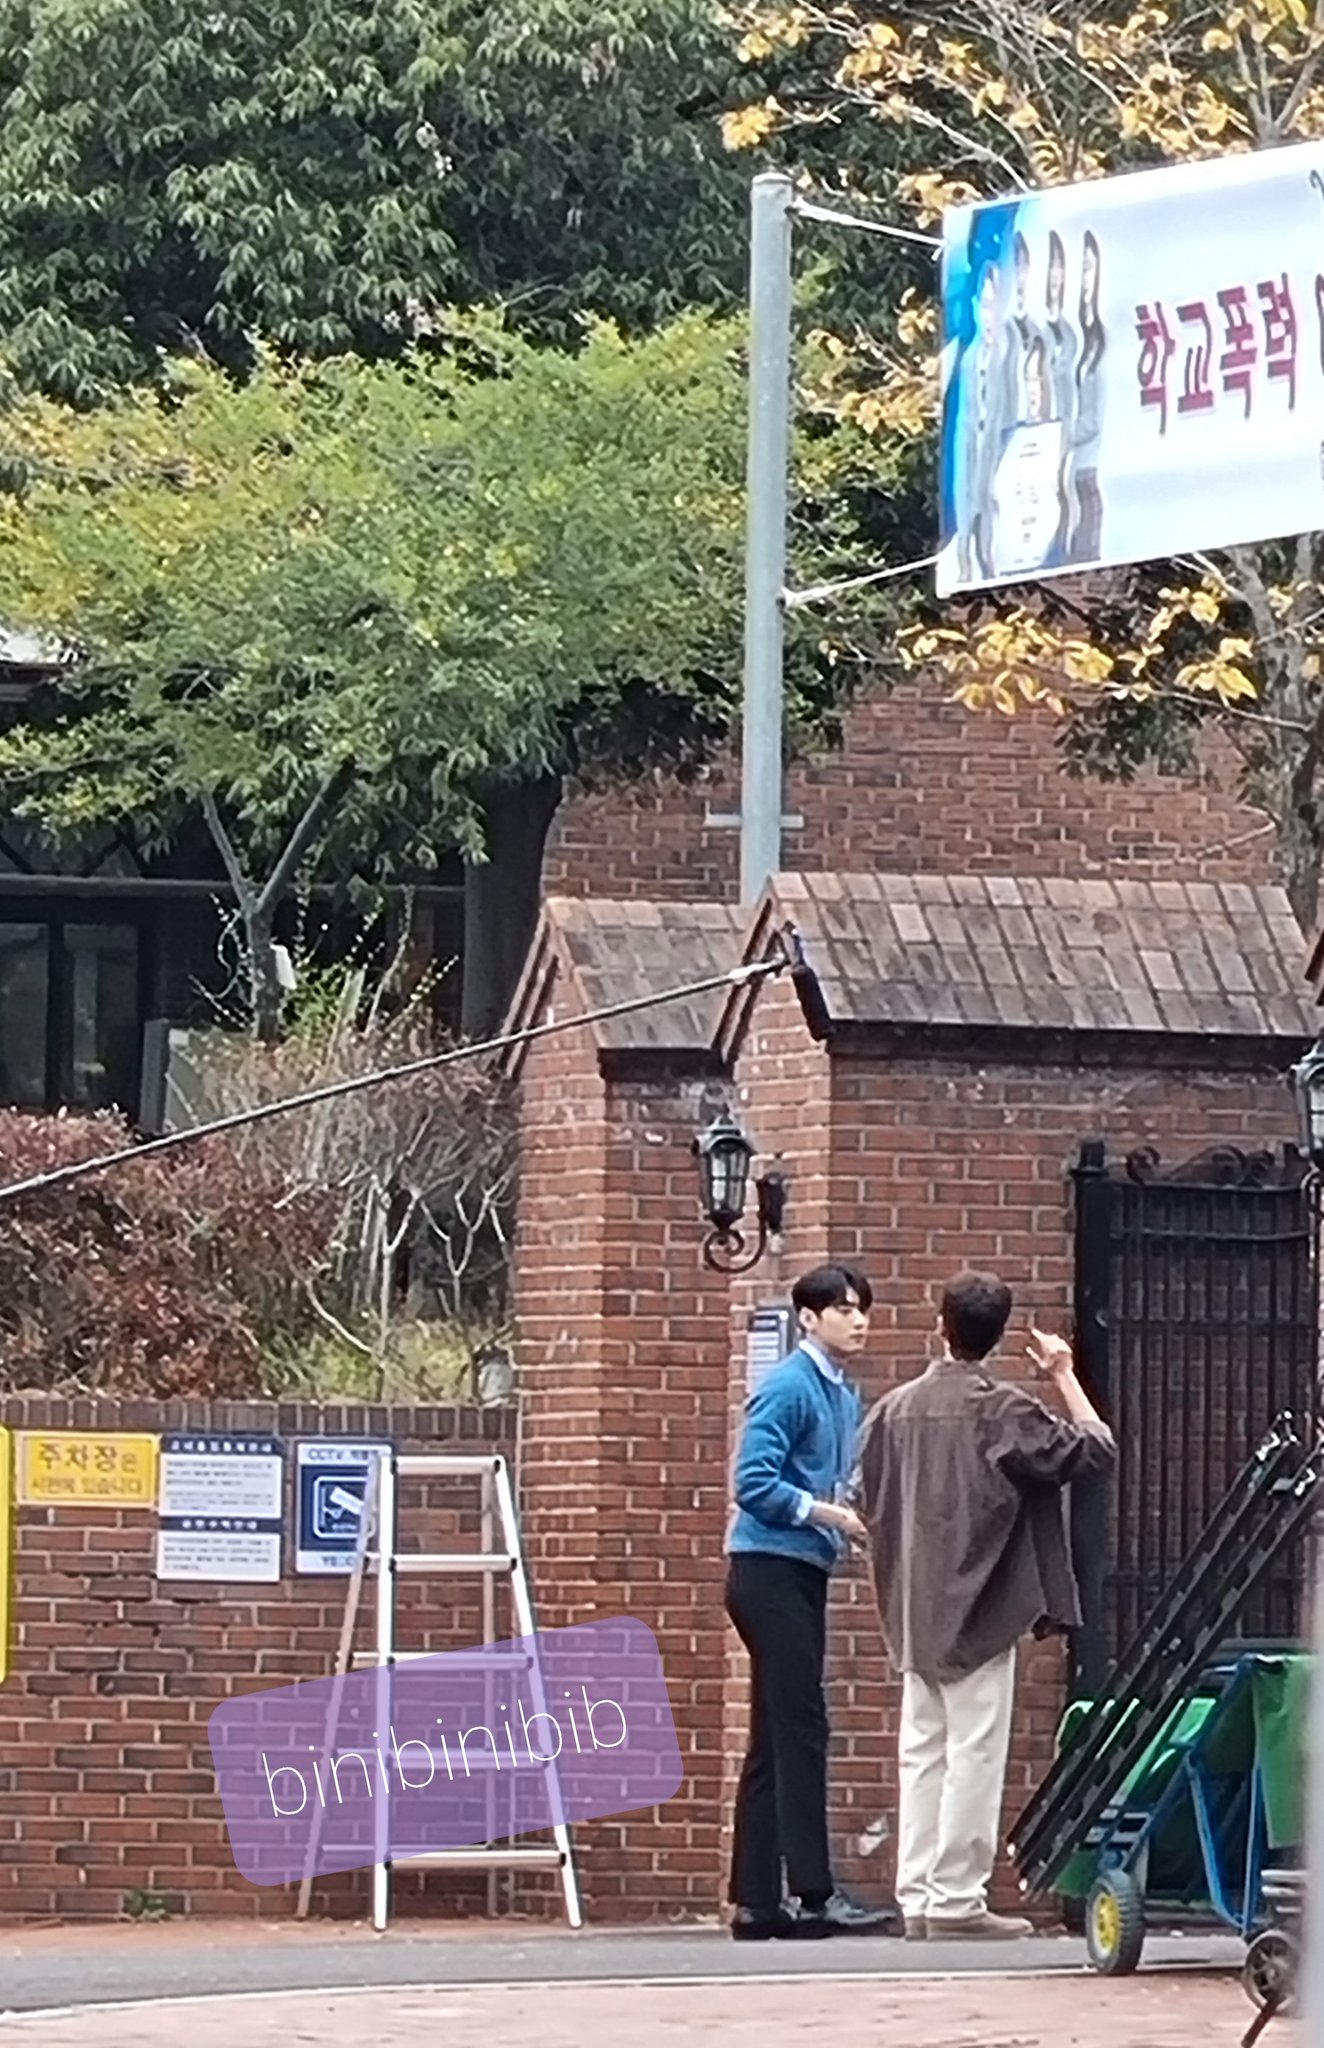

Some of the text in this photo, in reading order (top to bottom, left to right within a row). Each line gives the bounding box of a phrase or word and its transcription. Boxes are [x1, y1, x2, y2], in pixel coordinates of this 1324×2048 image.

[1135, 271, 1297, 437] 학교폭력
[38, 1443, 138, 1474] 주차장은
[308, 1448, 345, 1461] CCTV
